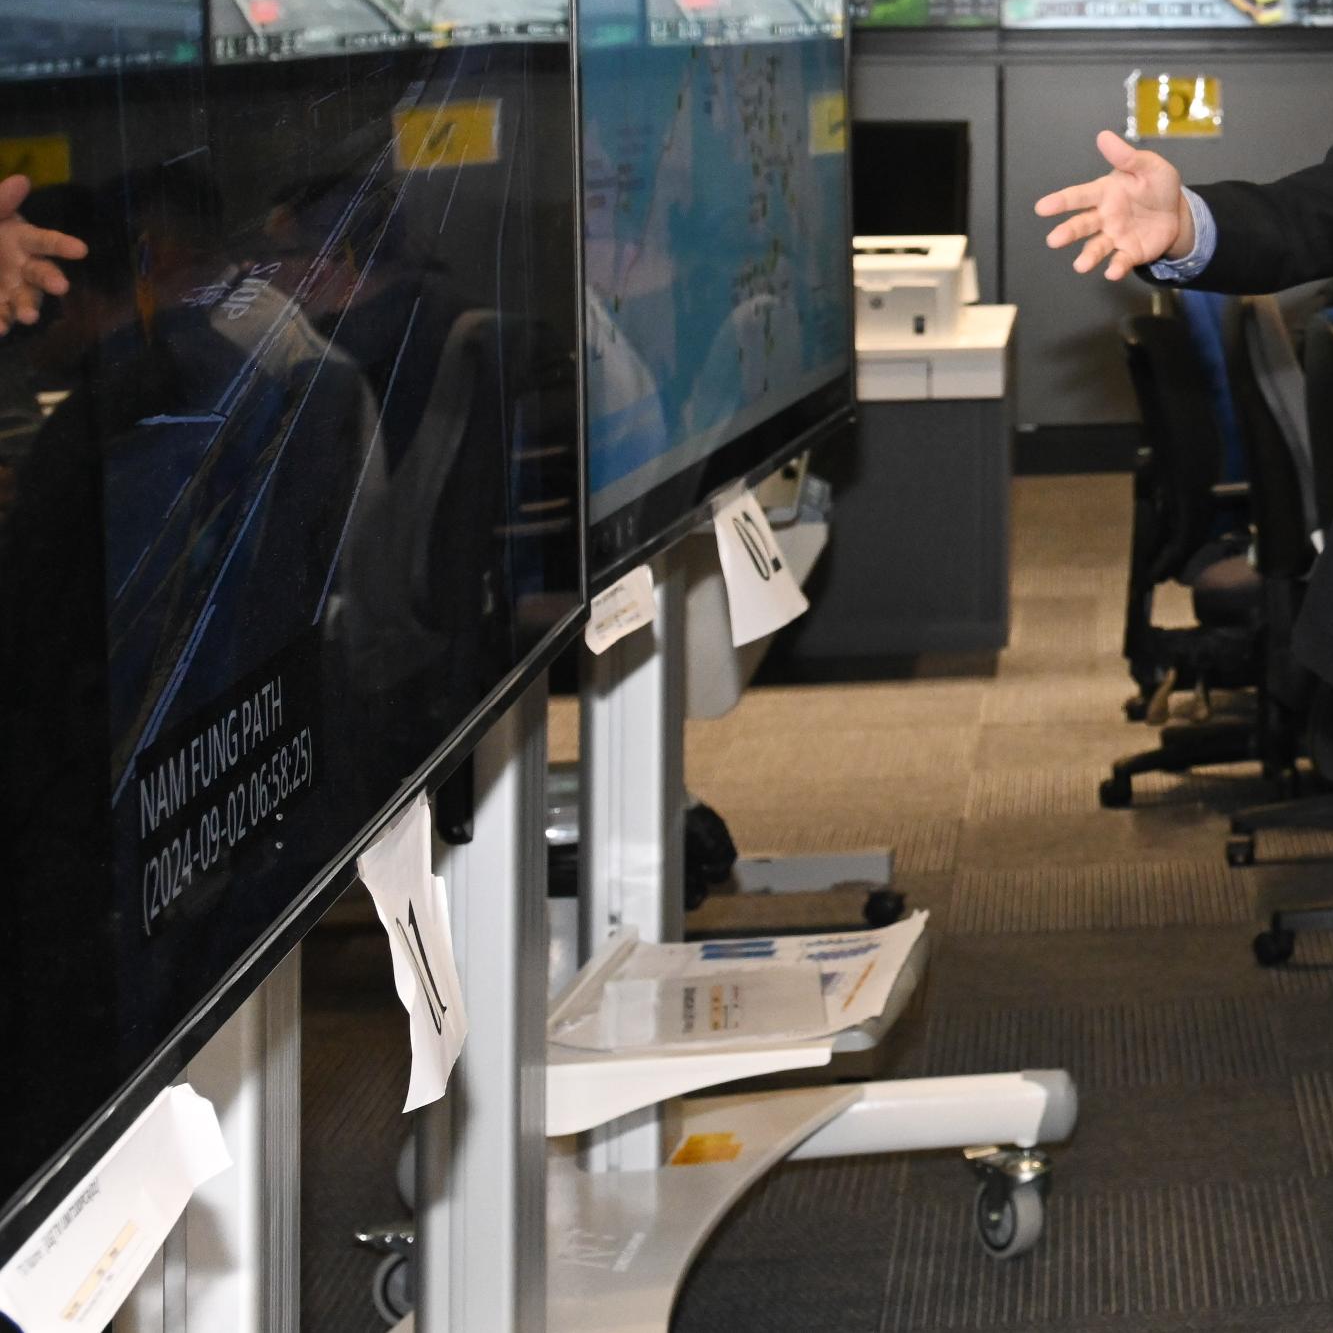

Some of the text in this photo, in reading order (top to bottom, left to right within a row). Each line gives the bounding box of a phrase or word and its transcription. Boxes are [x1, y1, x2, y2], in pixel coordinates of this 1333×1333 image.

[139, 675, 283, 840] NAM FUNG PATH
[142, 726, 312, 936] (2024-09-02 06:58:25)
